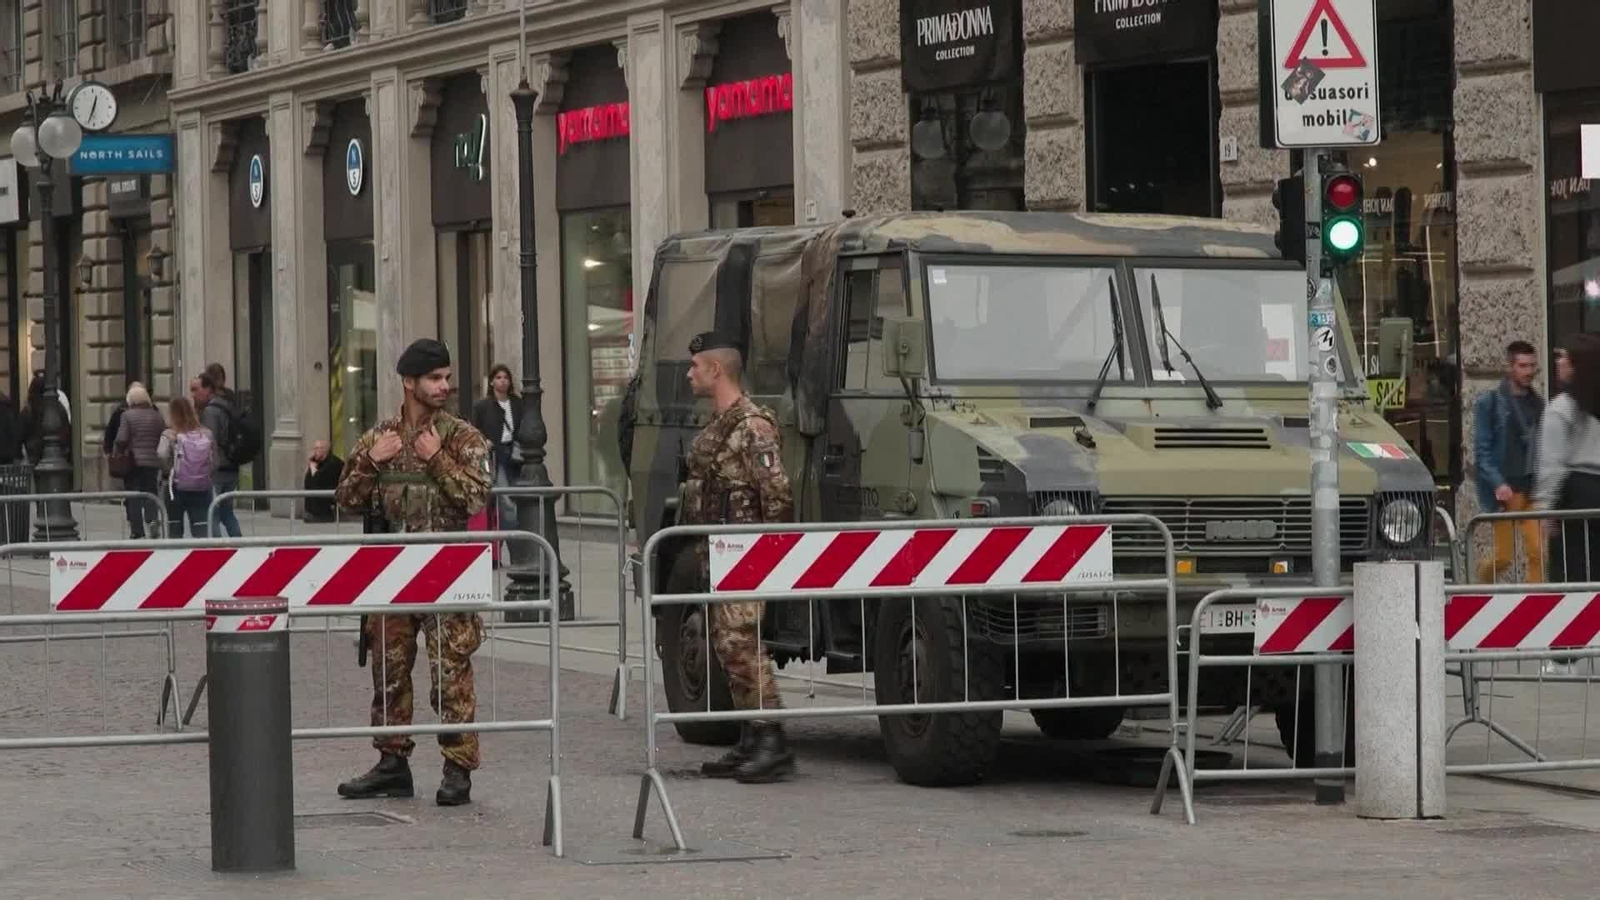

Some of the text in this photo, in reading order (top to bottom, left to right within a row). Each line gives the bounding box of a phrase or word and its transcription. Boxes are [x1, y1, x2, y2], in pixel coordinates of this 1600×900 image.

[916, 5, 994, 47] PRIMADONNA
[1115, 13, 1162, 29] COLLECTION
[935, 45, 975, 61] COLLECTION
[1284, 82, 1370, 101] suasori
[1303, 110, 1347, 127] mobil
[80, 149, 164, 160] NORTH SAILS
[1375, 381, 1404, 407] SALE
